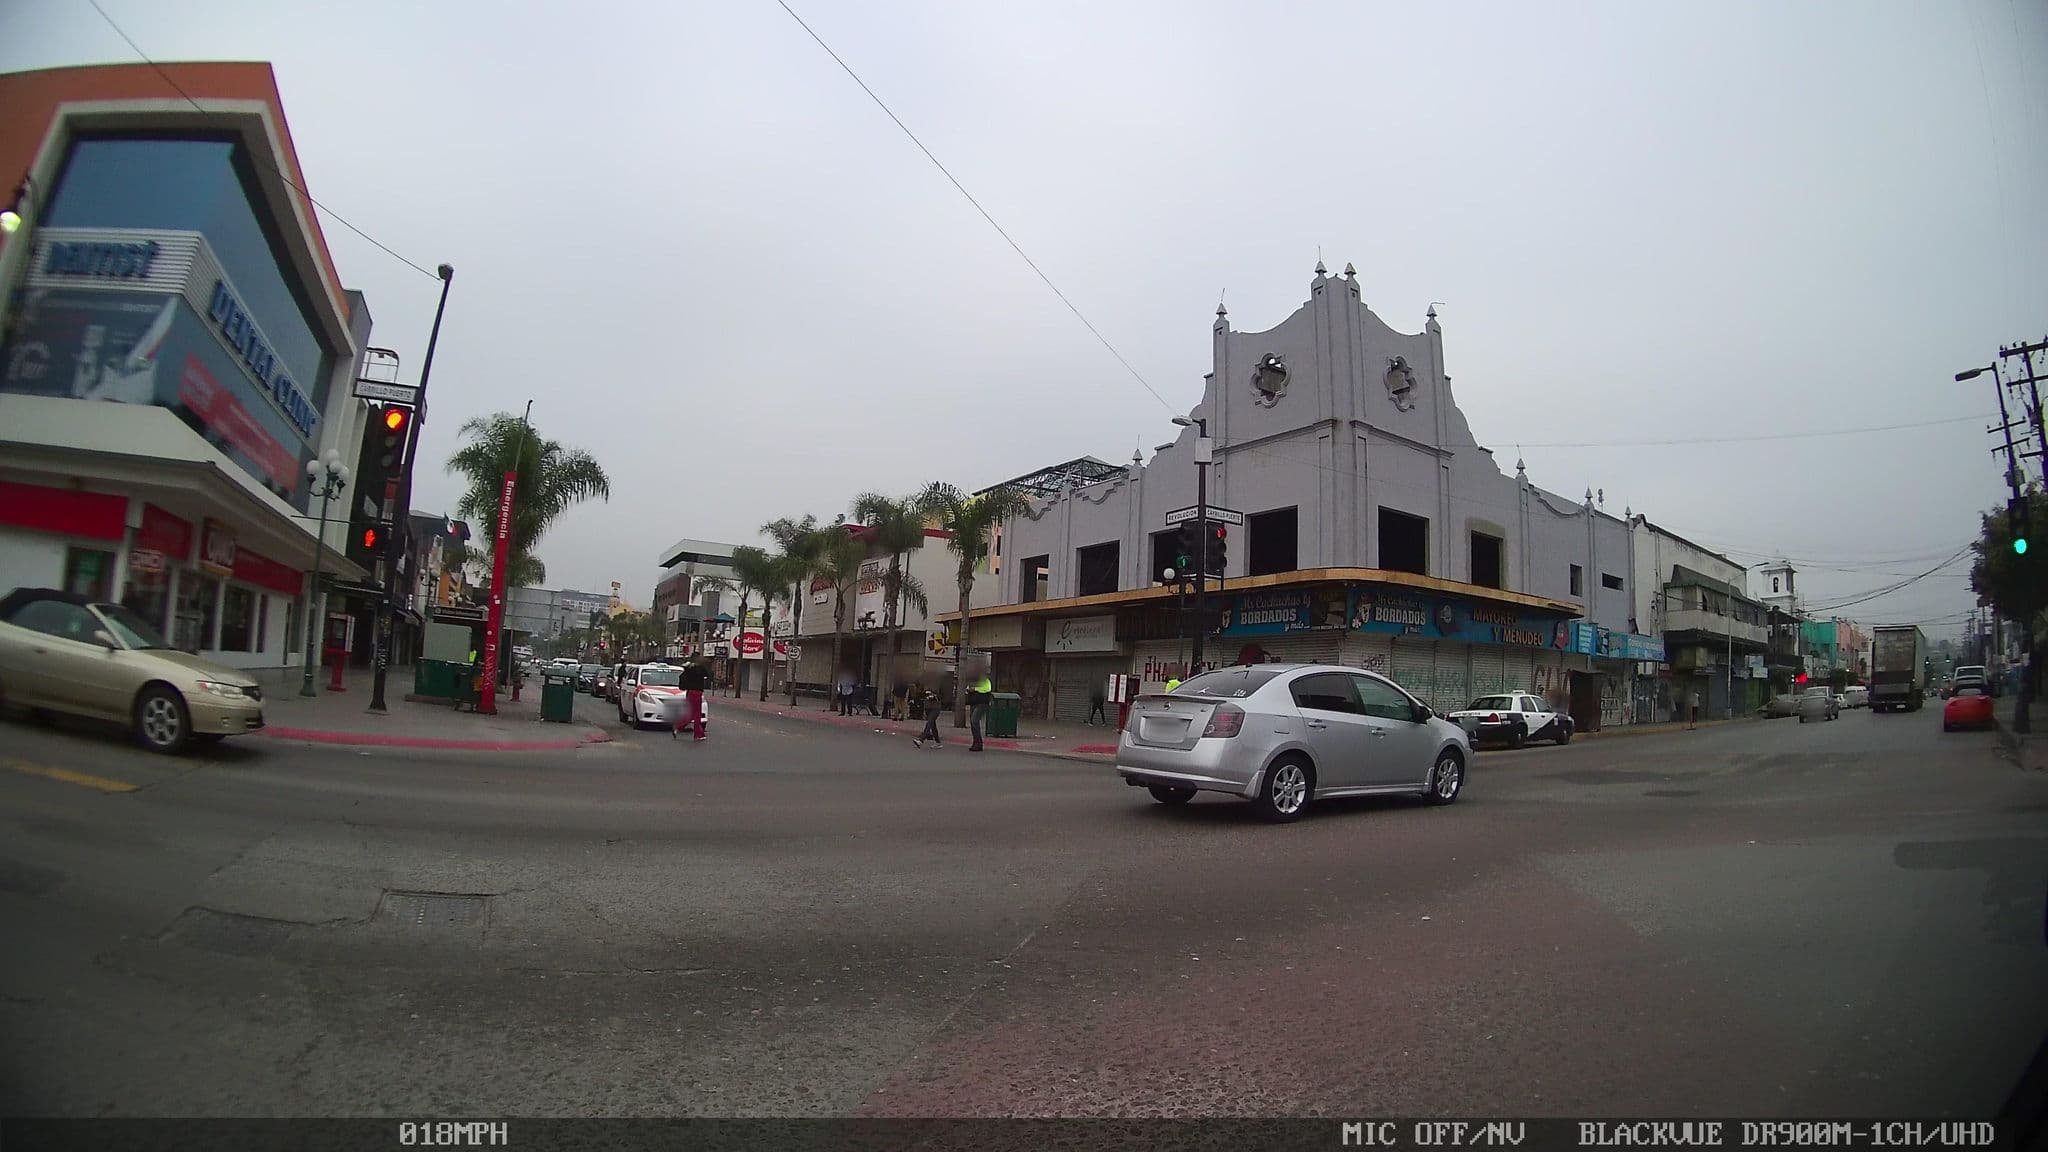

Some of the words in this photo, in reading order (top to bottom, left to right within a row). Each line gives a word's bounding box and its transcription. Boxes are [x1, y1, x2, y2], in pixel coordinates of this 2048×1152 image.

[47, 241, 160, 278] DENTIST
[209, 279, 275, 390] DENTAL
[274, 374, 317, 437] CLINIC
[389, 388, 412, 399] PUERTO
[499, 479, 515, 539] Emergencia
[1168, 509, 1197, 521] REVOLUCION
[1240, 608, 1297, 625] BORDADOS
[1375, 606, 1426, 626] BORDADOS
[1473, 607, 1520, 625] MAYOREO
[1494, 626, 1499, 641] Y
[1503, 627, 1544, 646] MENUDEO
